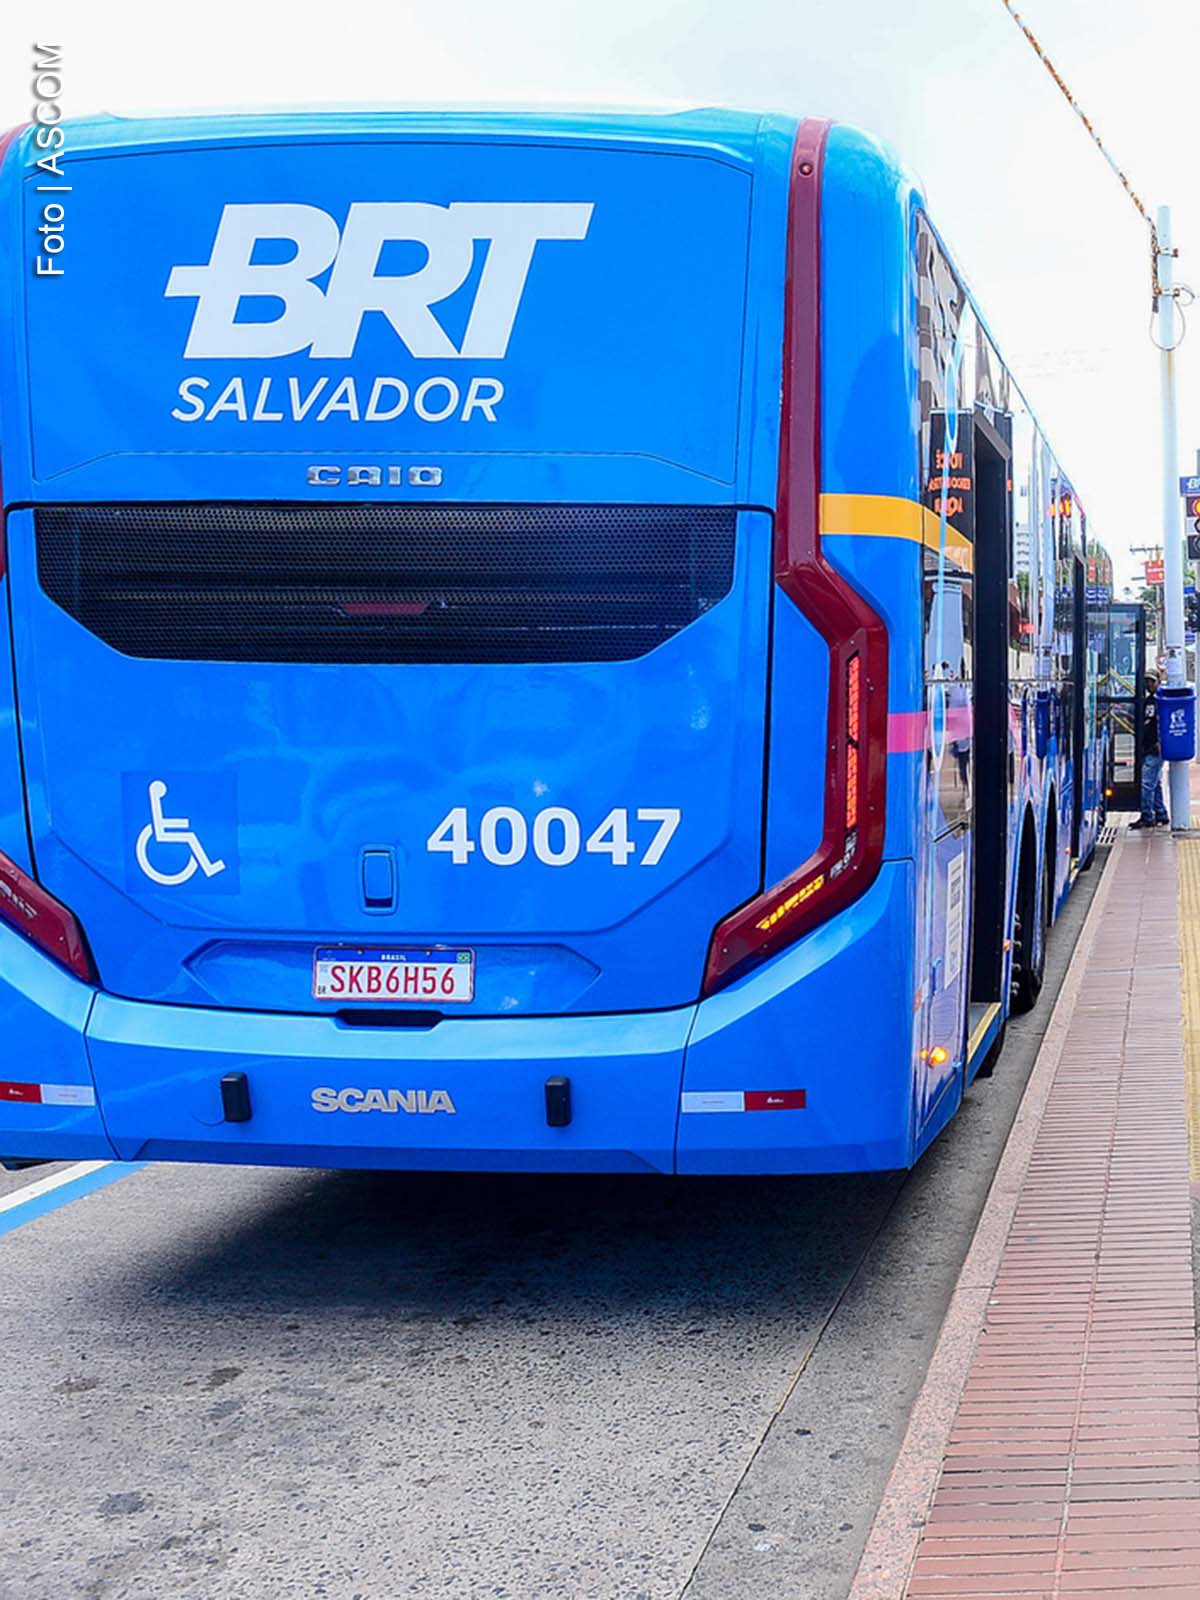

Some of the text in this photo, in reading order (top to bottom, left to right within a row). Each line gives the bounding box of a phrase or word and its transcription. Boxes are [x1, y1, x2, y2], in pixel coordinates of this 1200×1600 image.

[164, 202, 595, 359] BRT
[171, 376, 505, 422] SALVADOR
[306, 465, 444, 487] CAIO
[426, 806, 682, 866] 40047
[330, 965, 455, 994] SKB6H56
[311, 1087, 457, 1115] SCANIA
